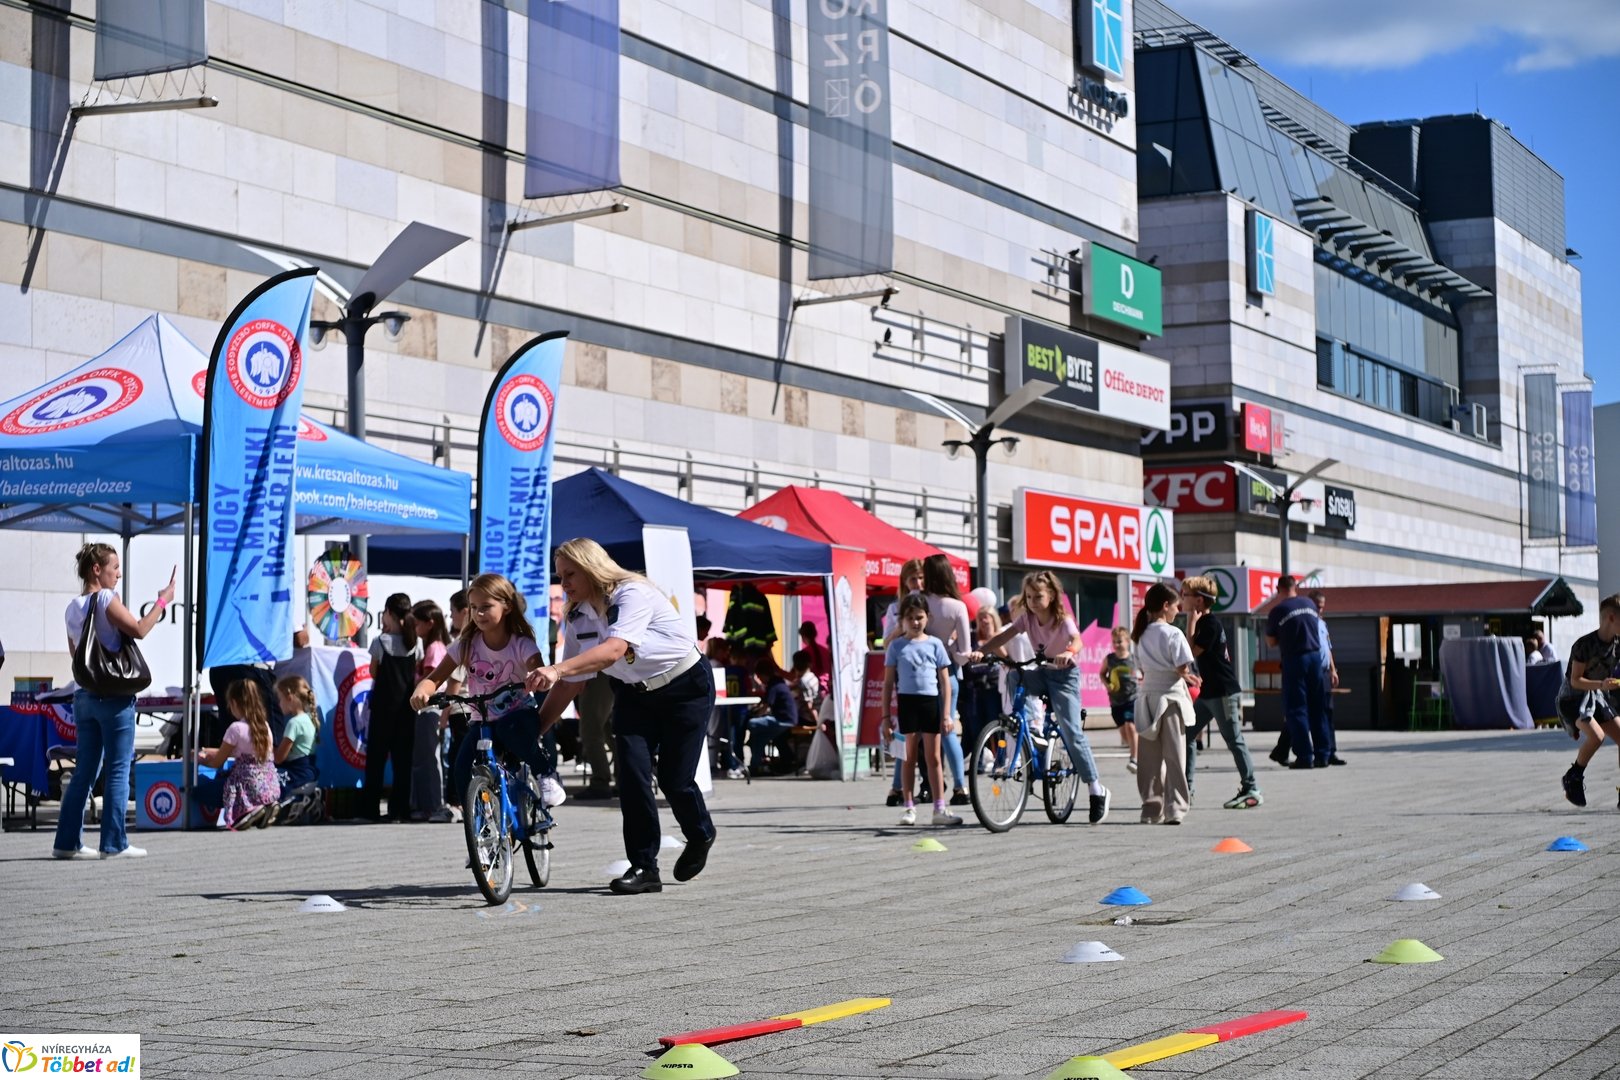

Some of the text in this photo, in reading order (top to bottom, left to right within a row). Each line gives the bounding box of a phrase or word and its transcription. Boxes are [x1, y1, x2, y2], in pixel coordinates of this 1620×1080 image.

[1121, 263, 1134, 299] D
[255, 321, 276, 331] ORFK
[1027, 343, 1093, 383] BEST BYTE
[1104, 369, 1135, 395] Office
[1136, 383, 1164, 403] DEPOT
[242, 427, 271, 551] MINDENKI
[262, 424, 298, 577] HAZAÉRJEN!
[1144, 471, 1227, 508] KFC
[1328, 489, 1354, 526] sinsay
[213, 483, 240, 552] HOGY
[1050, 505, 1140, 561] SPAR
[484, 516, 505, 574] HOGY
